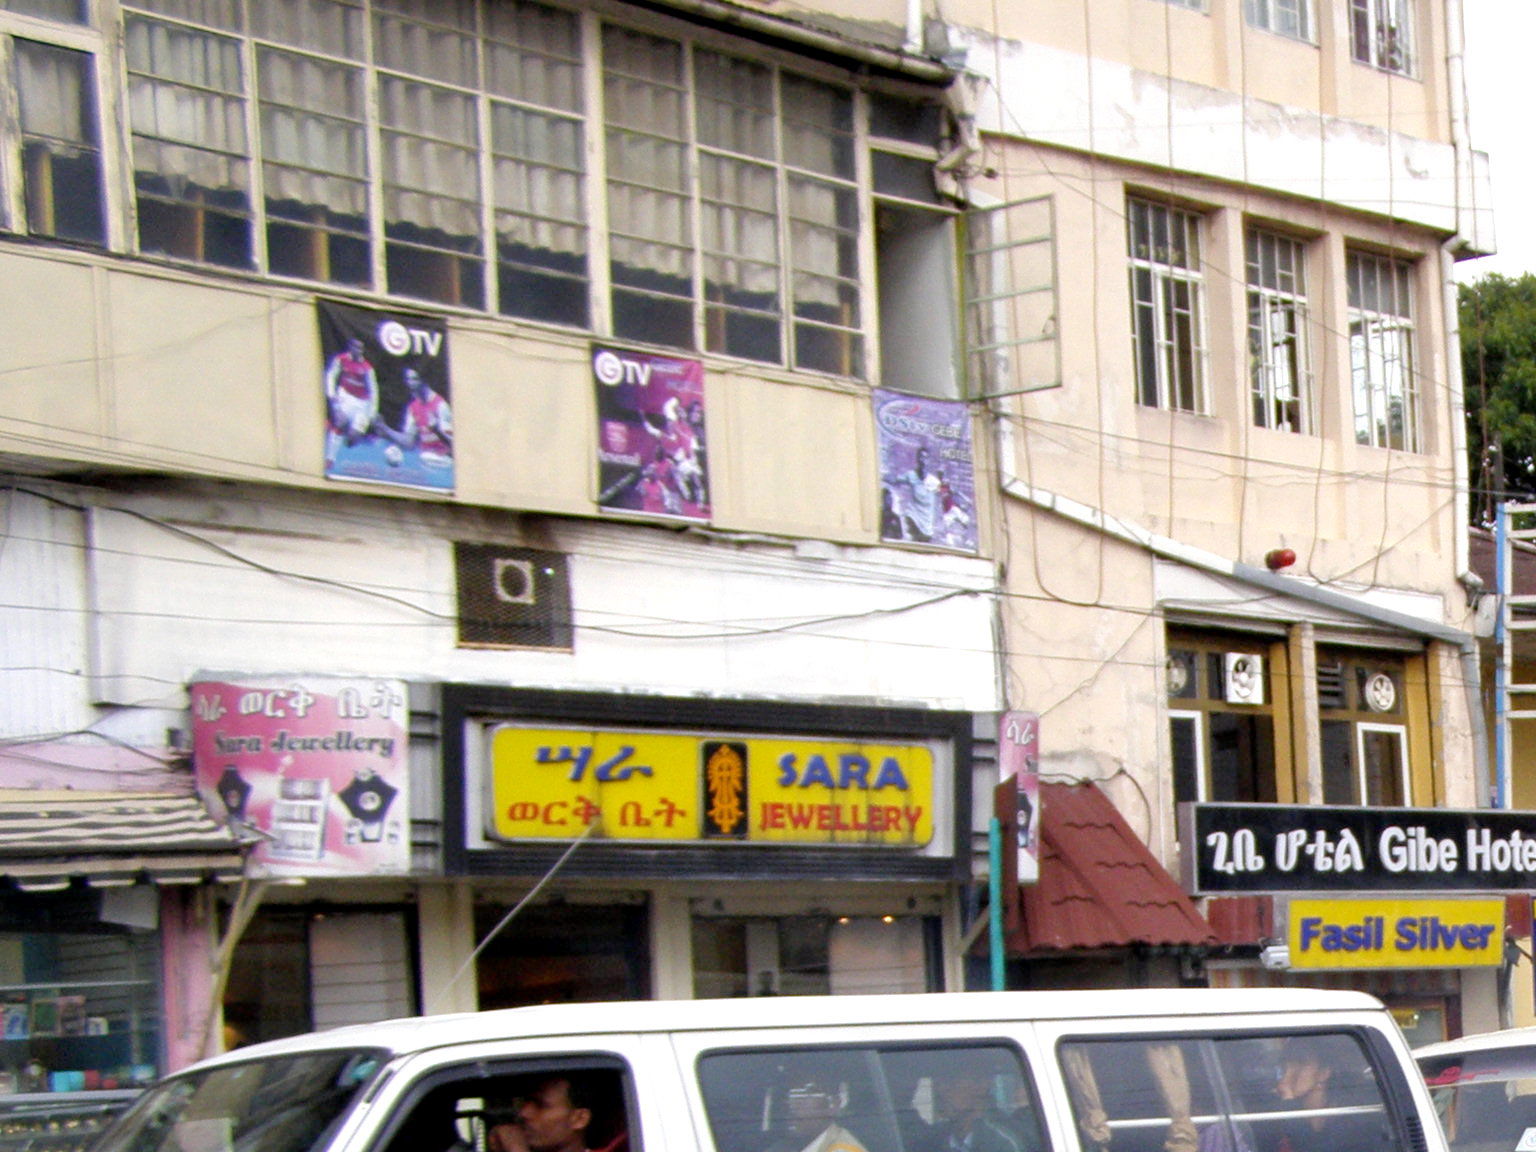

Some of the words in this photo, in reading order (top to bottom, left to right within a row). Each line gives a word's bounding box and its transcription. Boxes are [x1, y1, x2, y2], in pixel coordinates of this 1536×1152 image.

[238, 683, 316, 718] ወርቅ
[337, 680, 402, 719] ቤት
[214, 730, 261, 755] Sara
[271, 728, 395, 758] Jewellery
[535, 745, 654, 783] ሣራ
[777, 752, 909, 791] SARA
[507, 795, 601, 826] ወርቅ
[618, 797, 687, 828] ቤት
[759, 802, 923, 832] JEWELLERY
[1206, 828, 1266, 876] ጊቤ
[1274, 827, 1365, 873] ሆቴል
[1378, 825, 1459, 874] Gibe
[1299, 916, 1385, 952] Fasil
[1394, 913, 1495, 952] Silver
